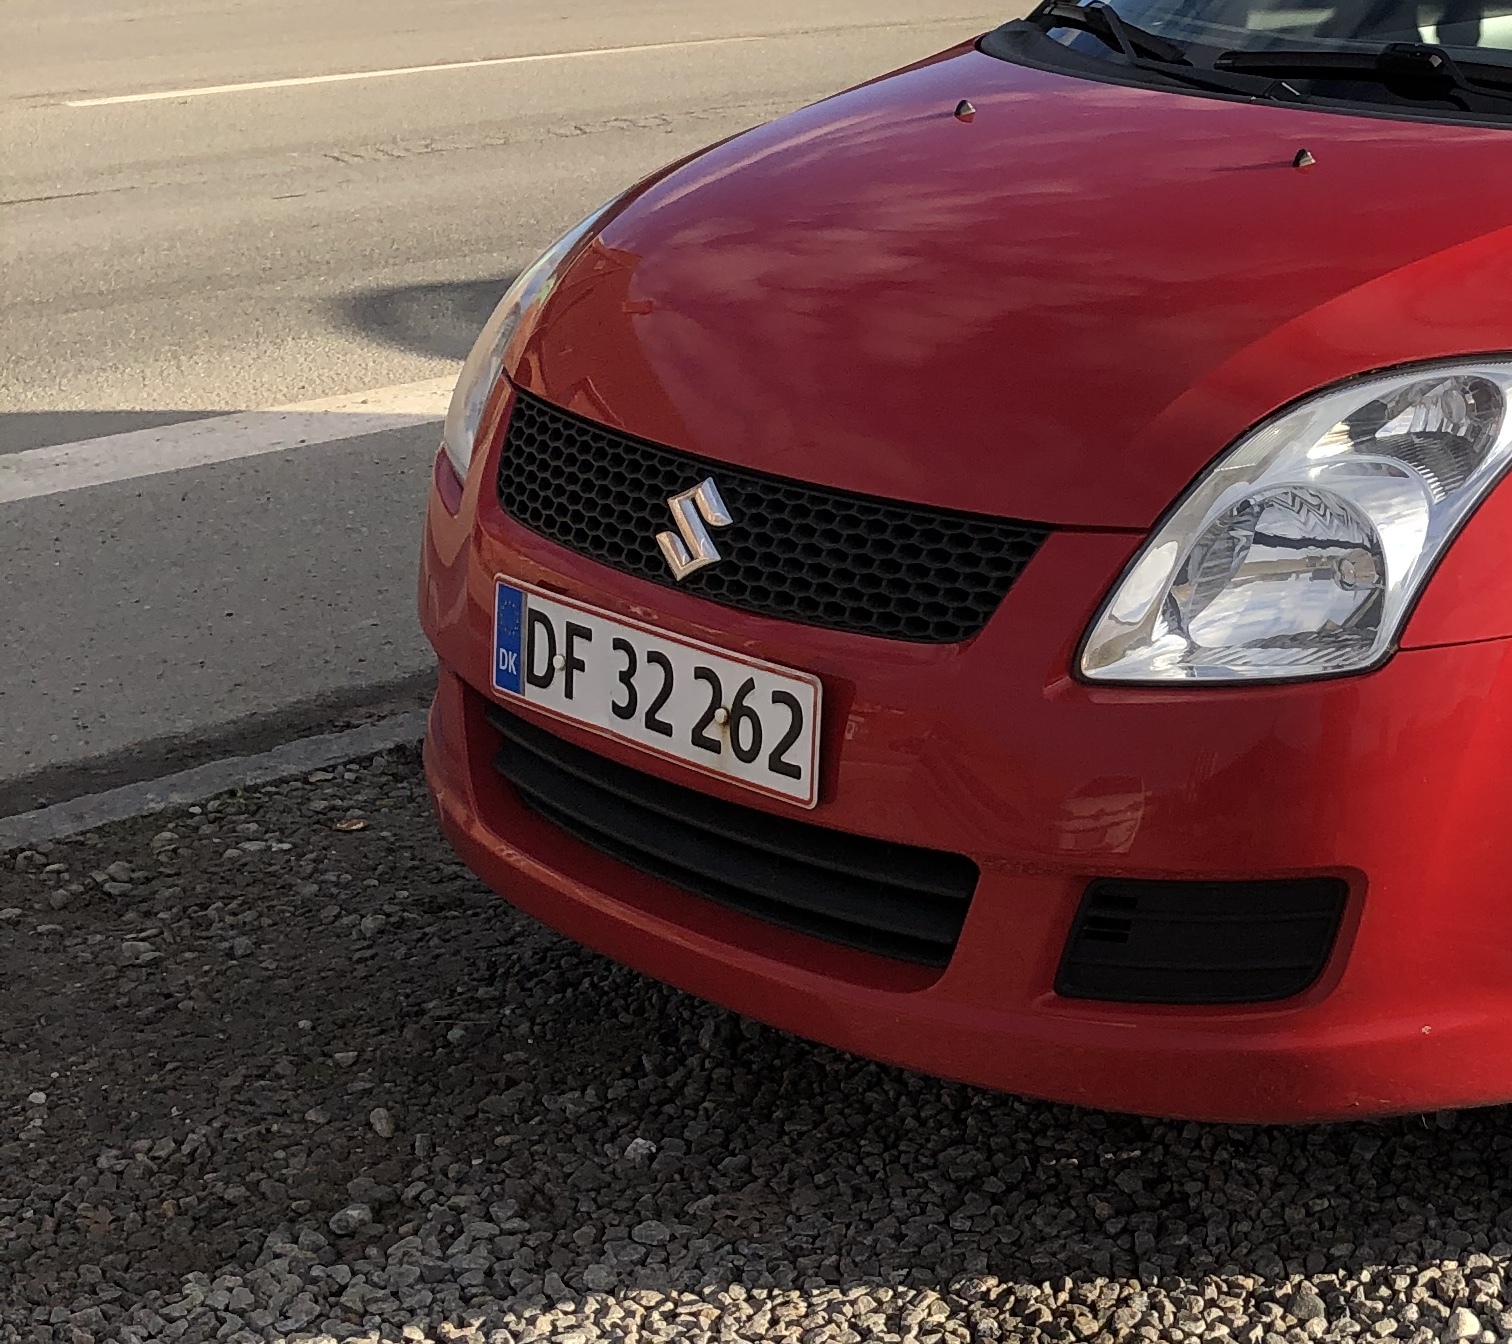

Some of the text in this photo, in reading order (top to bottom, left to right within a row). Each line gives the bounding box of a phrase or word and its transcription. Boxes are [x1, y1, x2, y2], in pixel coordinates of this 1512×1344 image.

[499, 647, 518, 676] DK
[526, 607, 804, 781] DF 32 262
